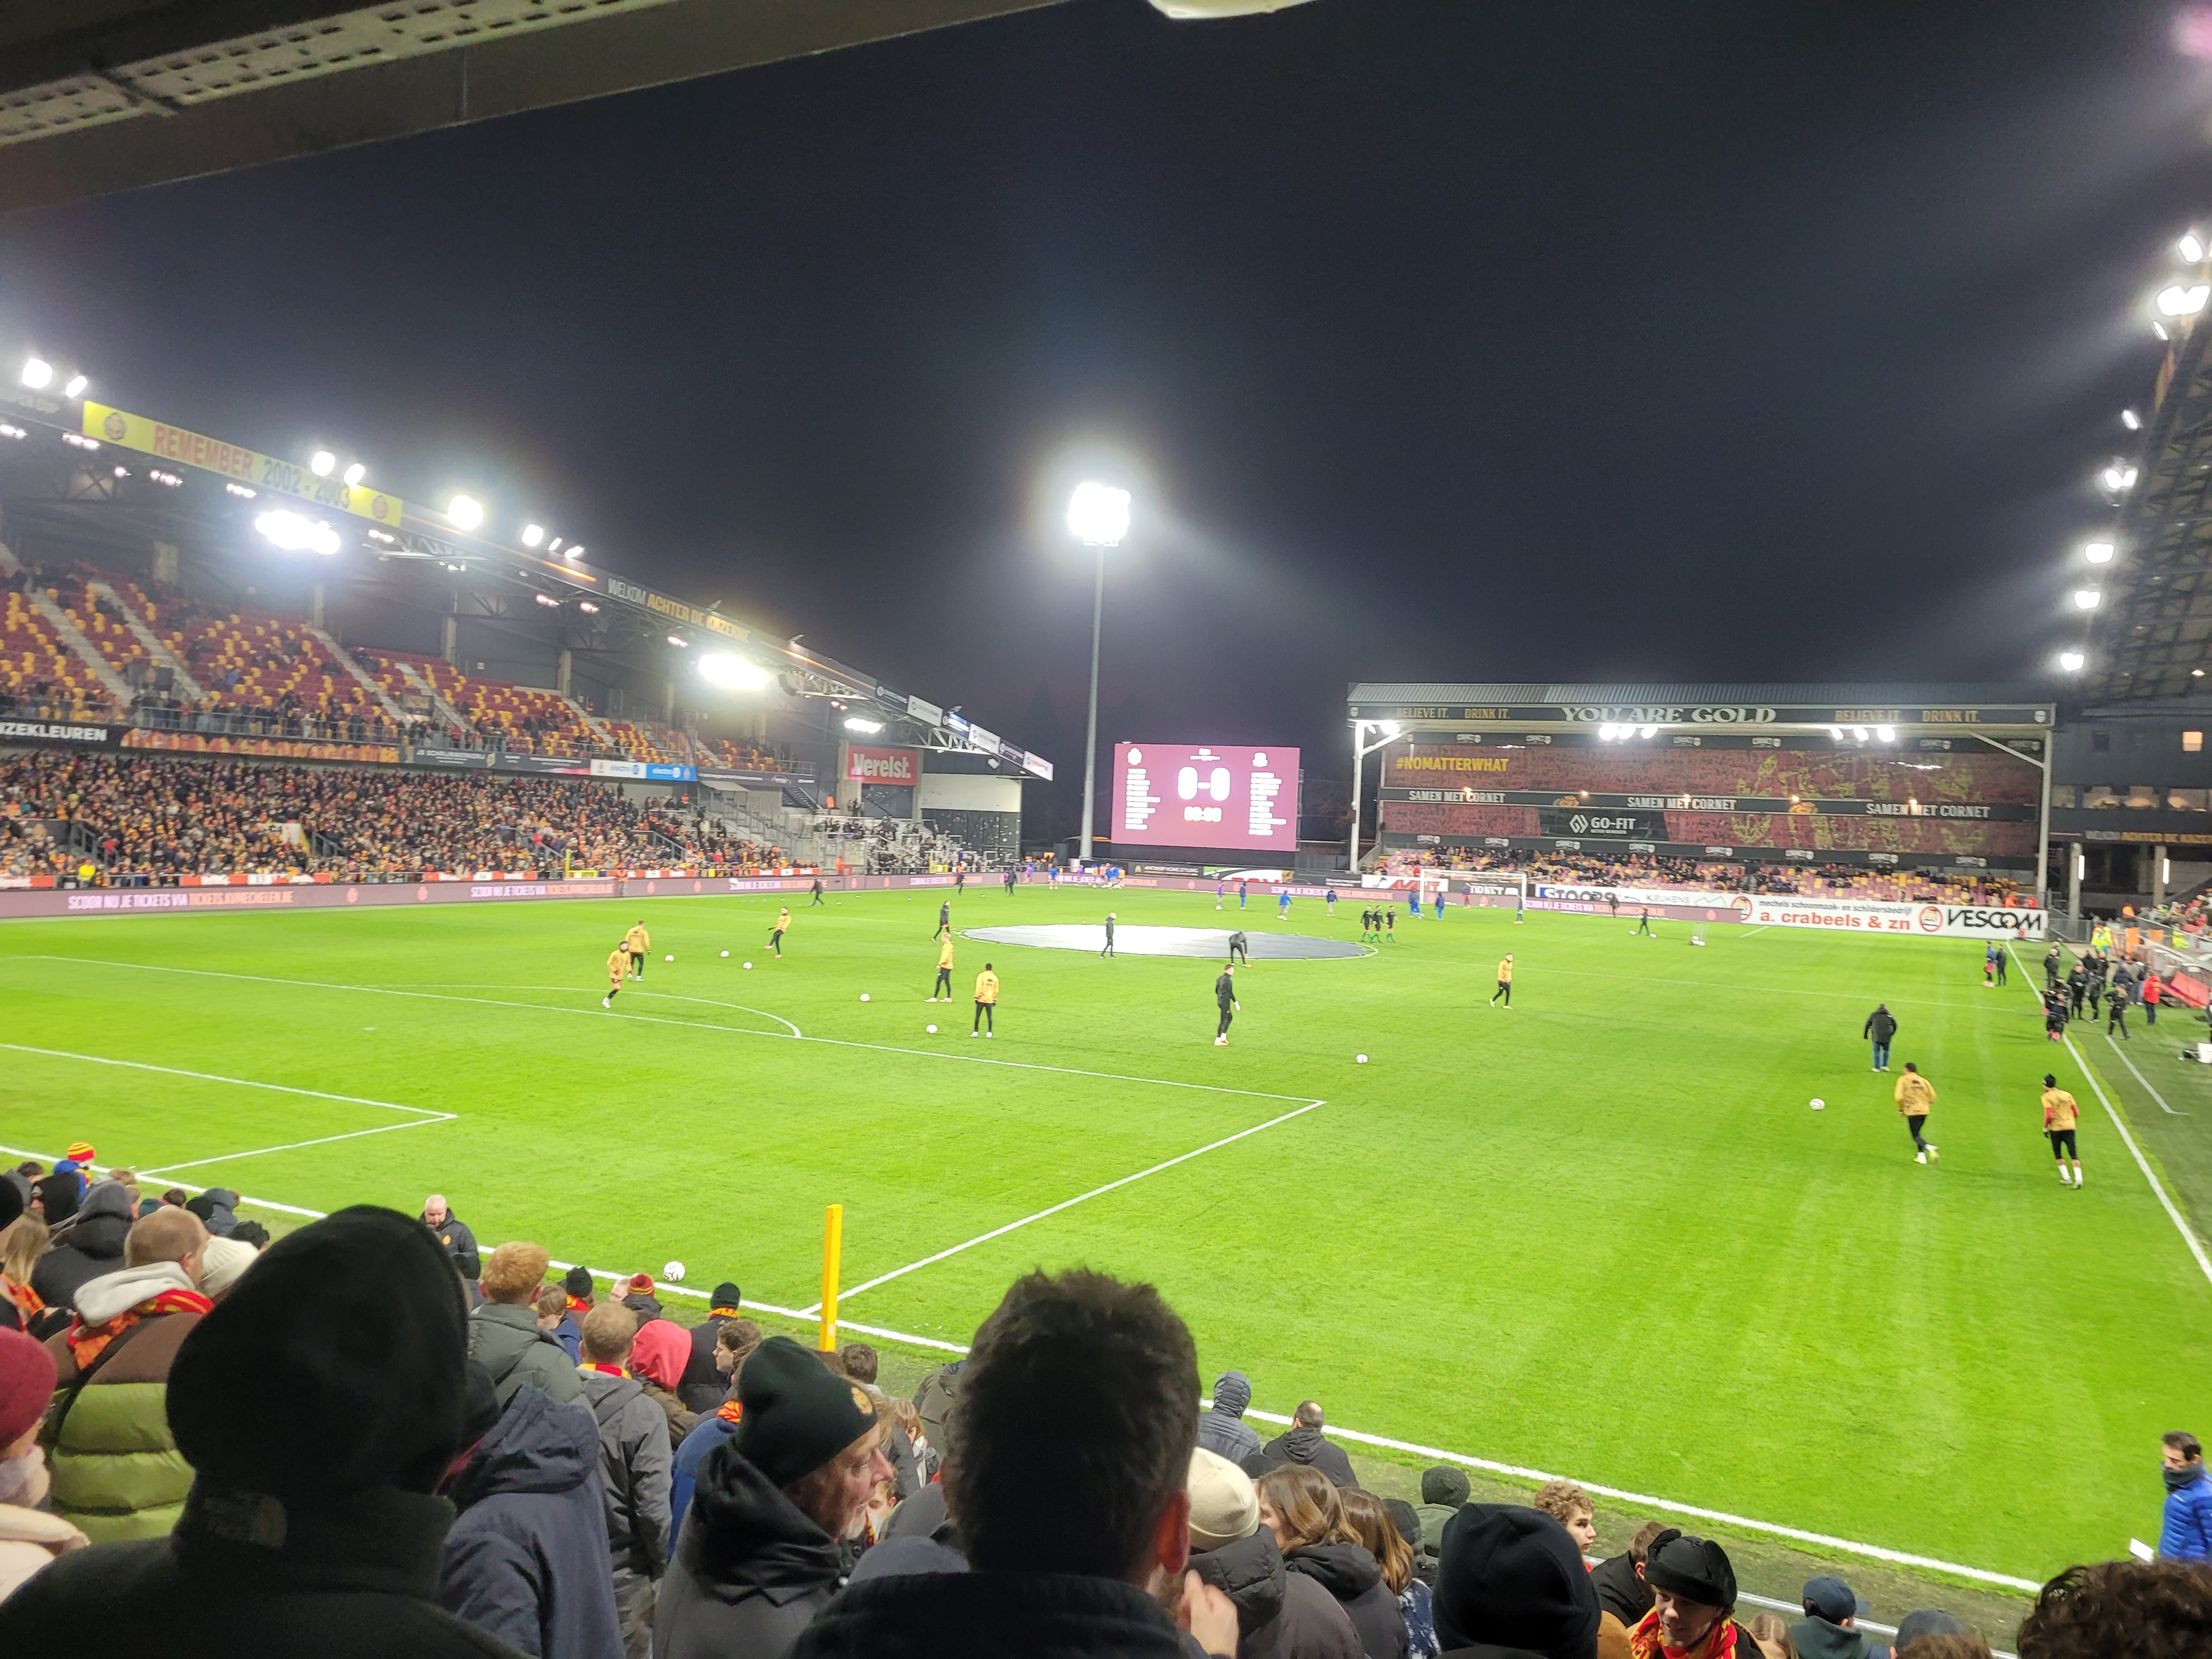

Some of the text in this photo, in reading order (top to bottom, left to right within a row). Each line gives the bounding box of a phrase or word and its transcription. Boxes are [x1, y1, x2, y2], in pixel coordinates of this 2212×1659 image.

[153, 424, 253, 481] REMEMBER
[262, 459, 302, 492] 2002
[608, 578, 751, 644] WELKOM ACHTER DE KAZERNE
[1396, 708, 1435, 718] BELIEVE
[1465, 708, 1510, 719] DRINK IT.
[1562, 707, 1776, 723] YOU ARE GOLD
[1835, 710, 1885, 722] BELIEVE
[1922, 710, 1962, 723] DRINK
[853, 753, 911, 778] Verelst.
[1396, 757, 1509, 771] #NOMATTERWHAT
[1409, 791, 1506, 803] SAMEN MET CORNET
[1627, 797, 1737, 810] SAMEN MET CORNET
[1866, 802, 1990, 818] SAMEN MET CORNET
[1590, 817, 1637, 830] GO-FIT
[68, 895, 103, 910] SCOOR
[104, 895, 120, 909] NU
[120, 894, 133, 908] JE
[133, 894, 171, 907] TICKETS
[171, 893, 188, 906] VIA
[1646, 895, 1690, 904] KEUKENS
[1759, 900, 1789, 908] mechels
[1791, 901, 1840, 911] schoonmaak-
[1853, 905, 1912, 916] schildersbedrijf
[1760, 912, 1911, 930] a. crabeels & zn
[1948, 909, 2041, 931] VESCOM
